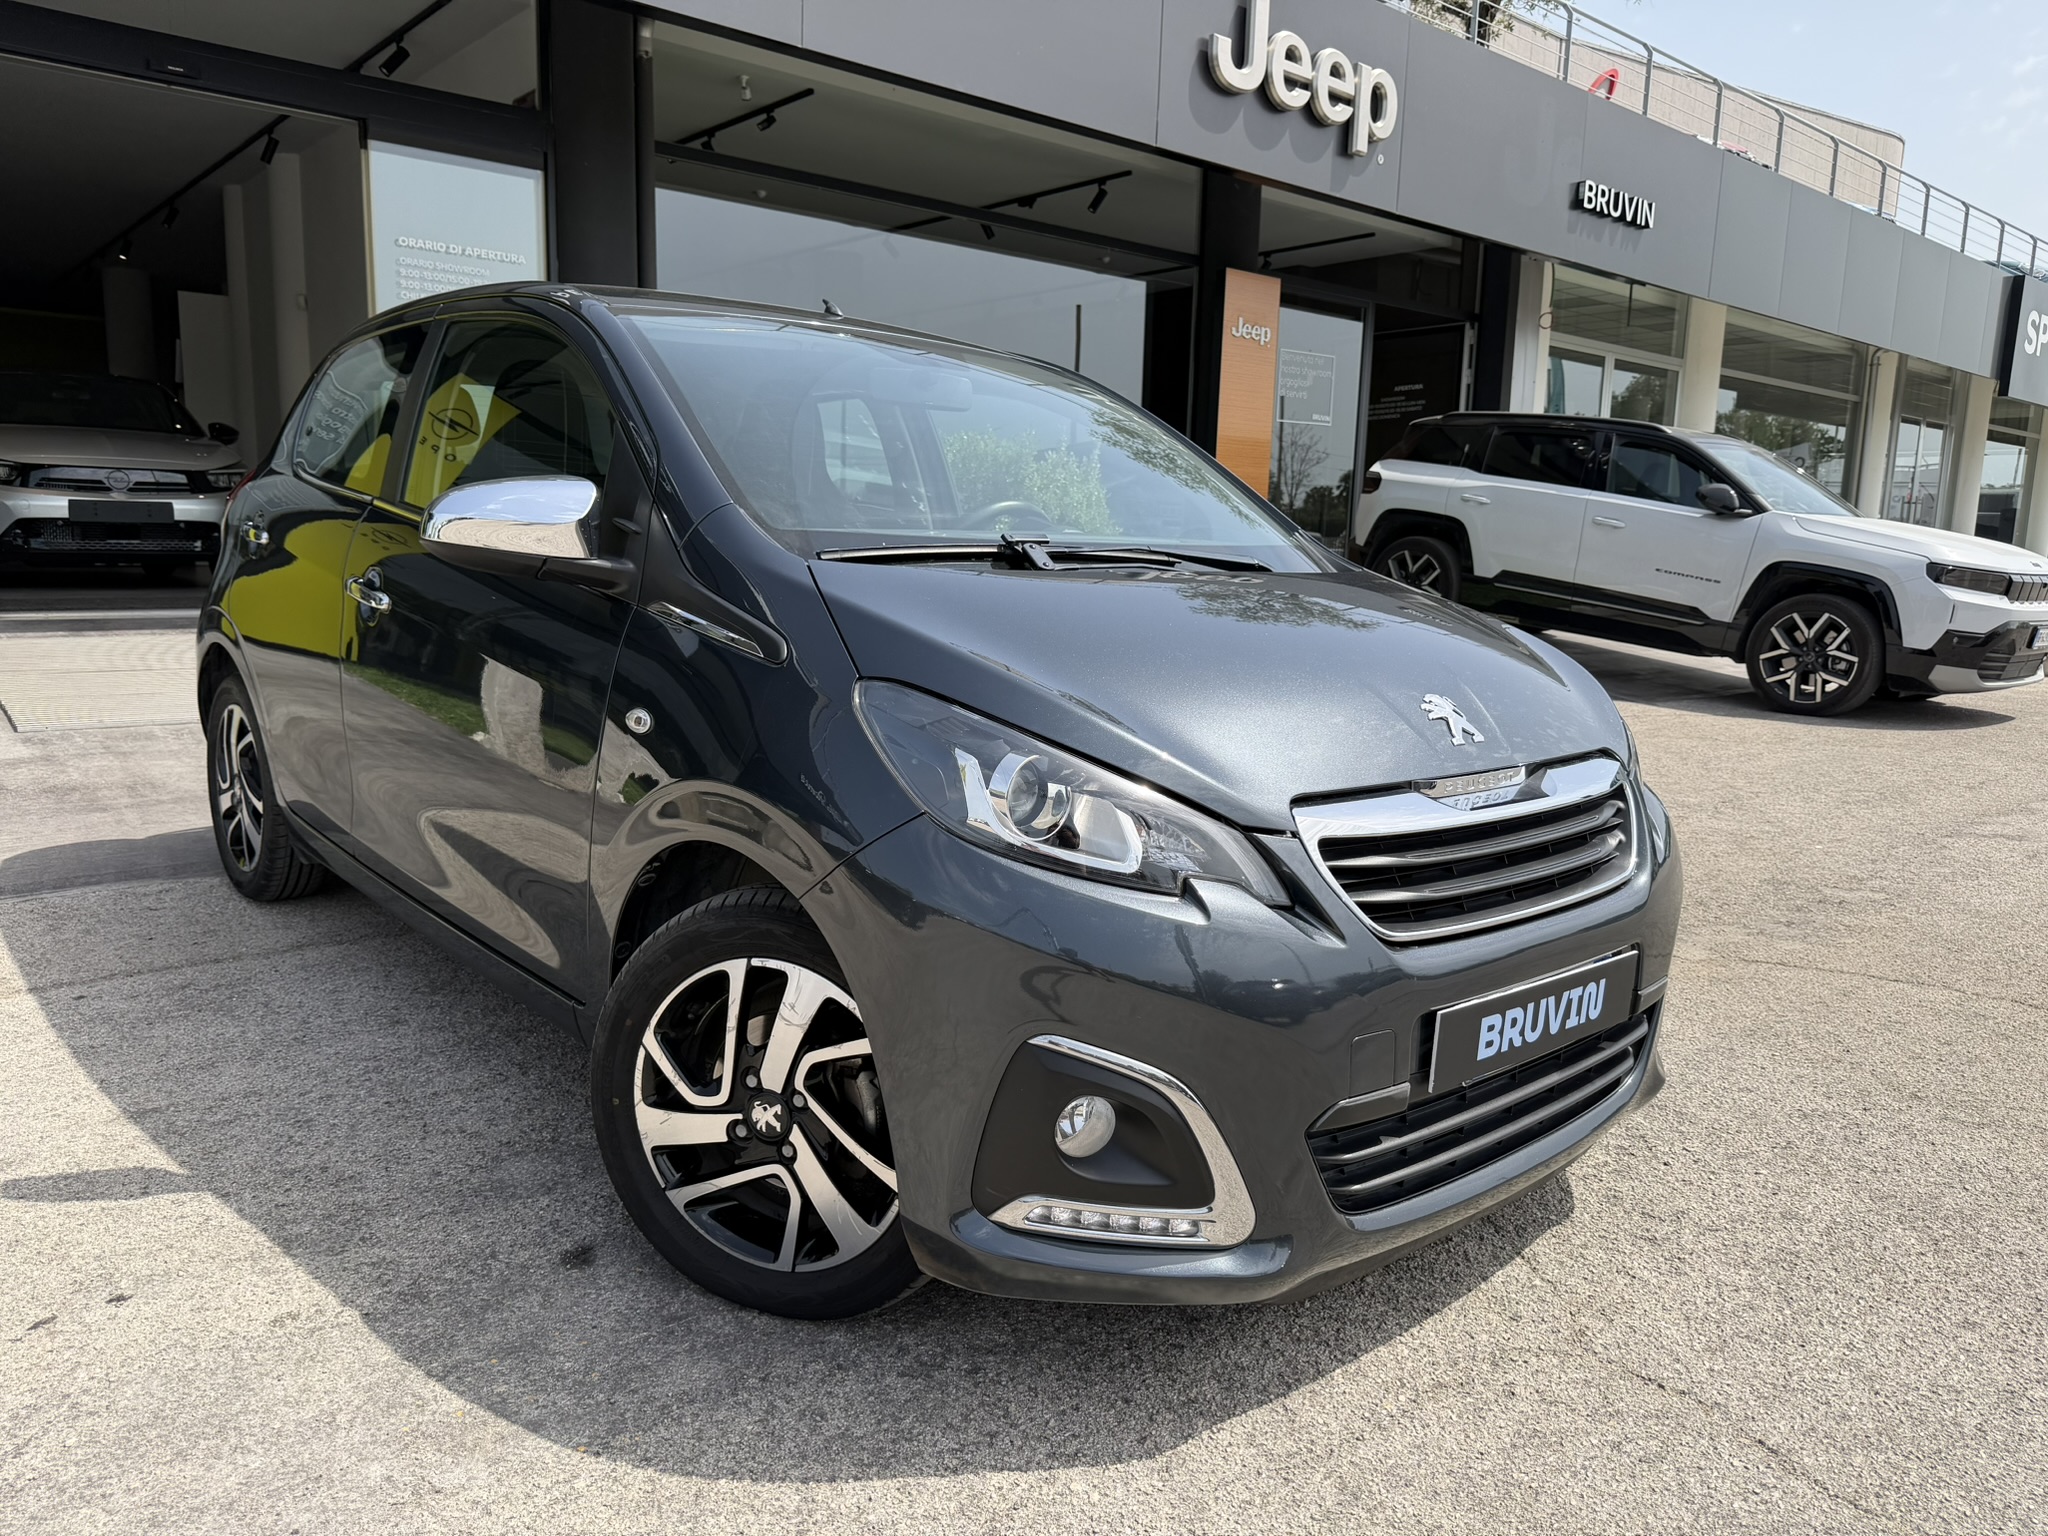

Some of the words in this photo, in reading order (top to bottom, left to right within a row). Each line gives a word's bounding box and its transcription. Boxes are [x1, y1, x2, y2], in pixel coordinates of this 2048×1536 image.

[1208, 0, 1398, 156] Jeep
[1581, 179, 1656, 229] BRUVIN
[398, 236, 446, 252] ORARIO
[449, 243, 462, 255] DI
[465, 246, 526, 264] APERTURA
[399, 256, 434, 269] ORARIO
[435, 261, 490, 277] SHOWROOM
[1231, 316, 1271, 345] Jeep
[1443, 771, 1515, 794] PEUGEOT
[1476, 978, 1607, 1062] BRUVIN
